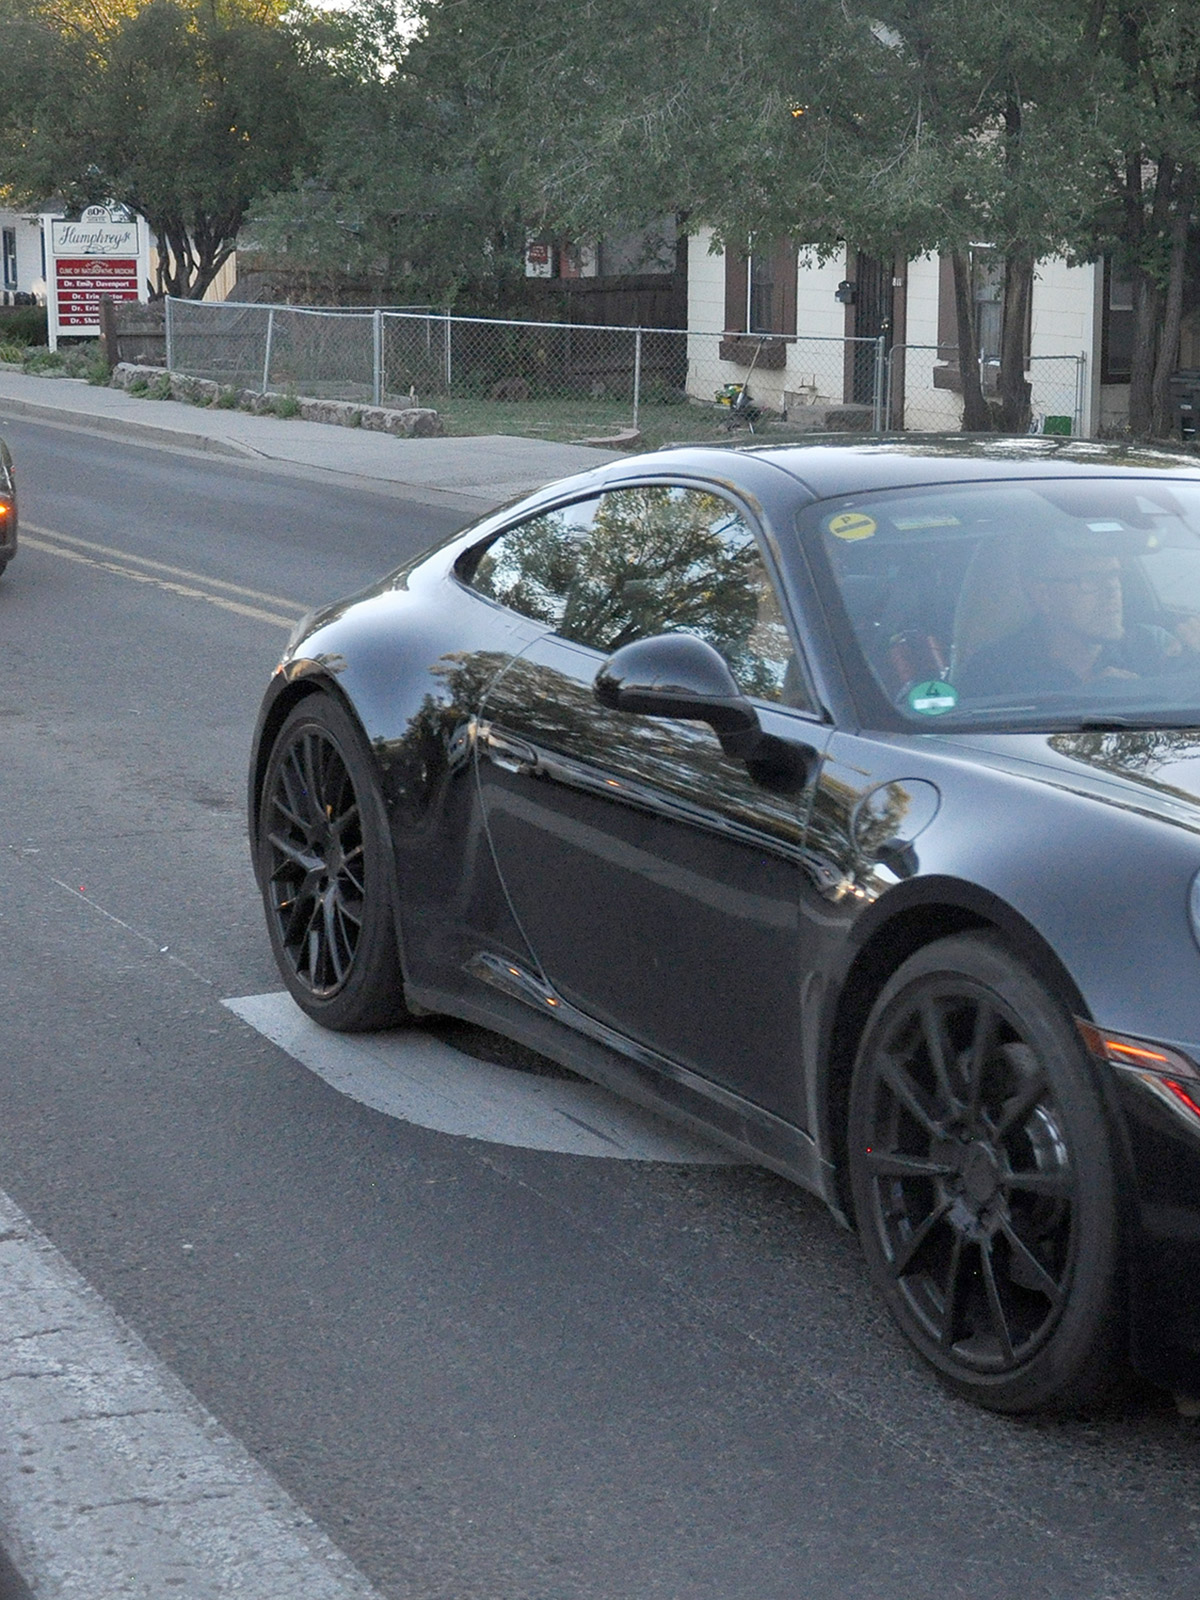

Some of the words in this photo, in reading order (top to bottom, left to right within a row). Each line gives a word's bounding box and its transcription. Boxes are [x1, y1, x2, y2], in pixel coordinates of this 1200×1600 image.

[87, 207, 105, 216] 809
[76, 280, 94, 288] Emily
[95, 280, 129, 288] Davenport
